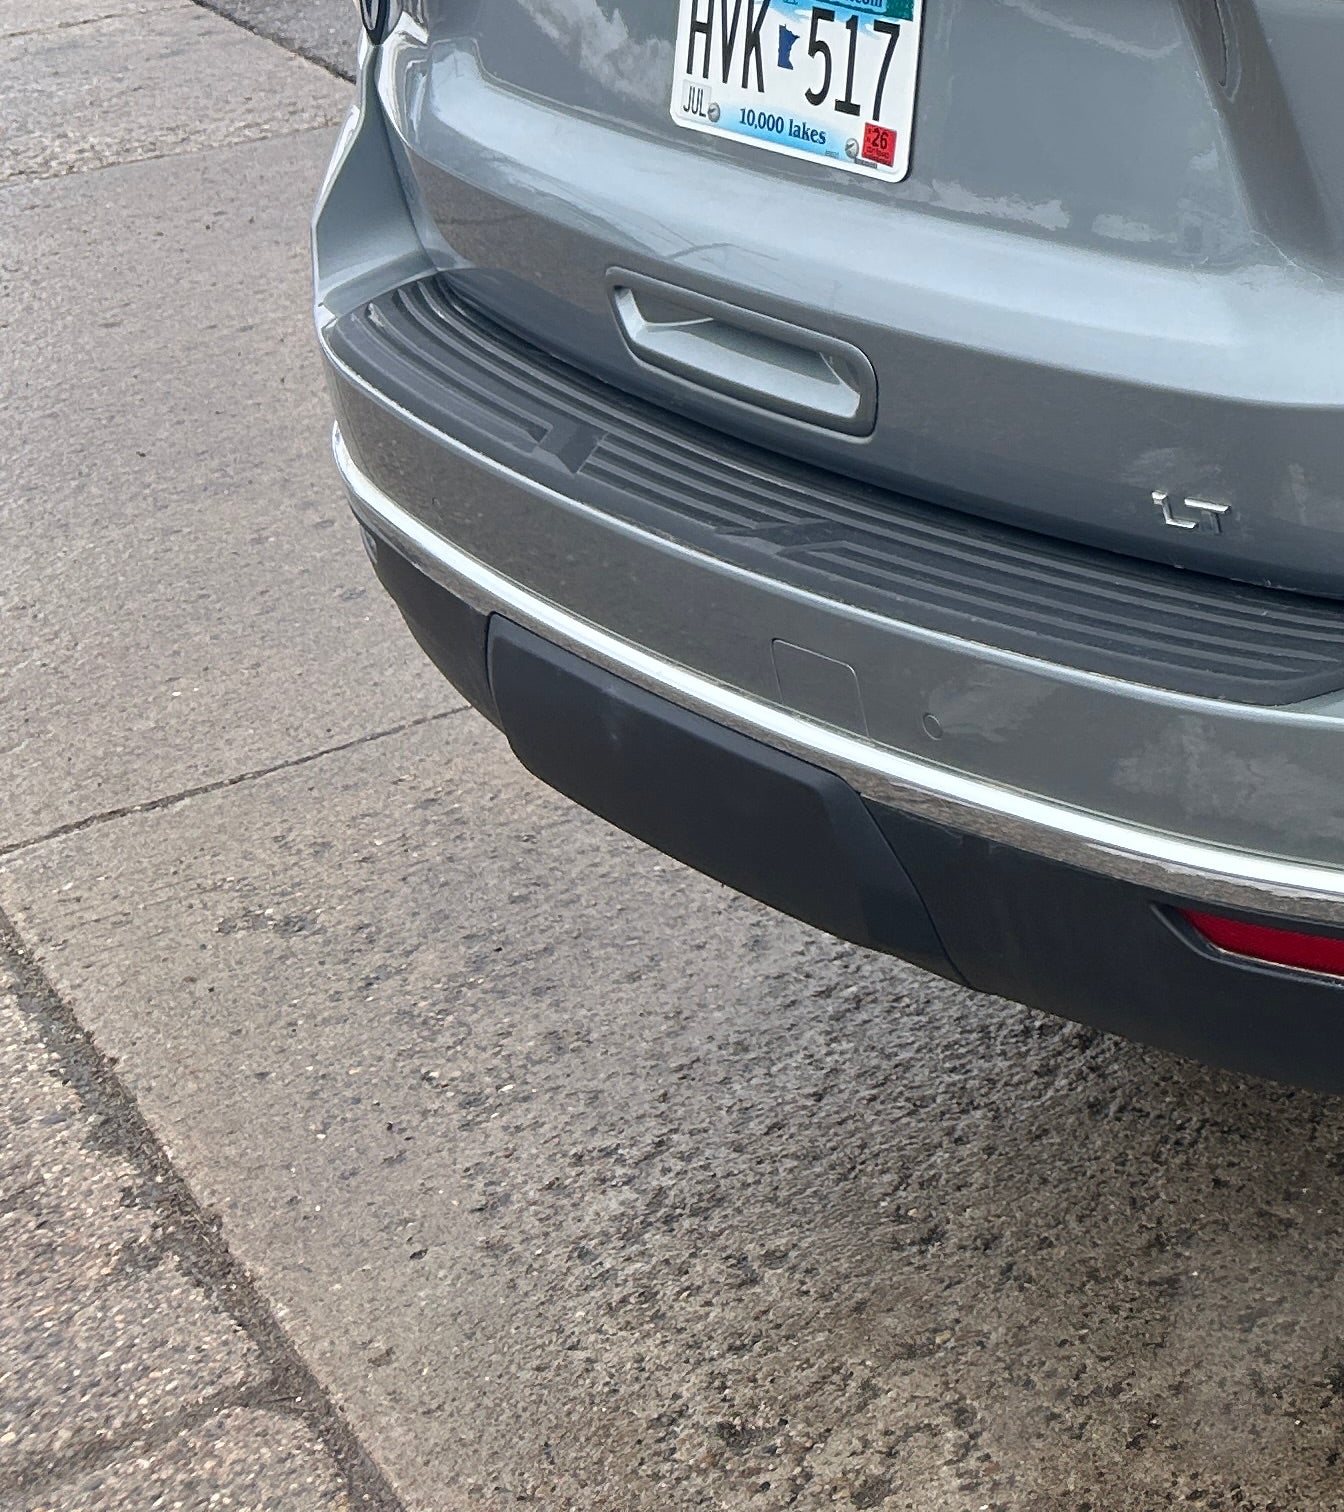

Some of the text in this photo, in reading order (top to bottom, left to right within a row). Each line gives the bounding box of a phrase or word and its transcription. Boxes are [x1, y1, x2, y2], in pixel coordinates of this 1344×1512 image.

[804, 6, 901, 121] 517
[682, 85, 707, 118] JUL
[739, 107, 827, 145] 10,000 lakes
[871, 127, 889, 149] 26
[1151, 490, 1232, 534] LT
